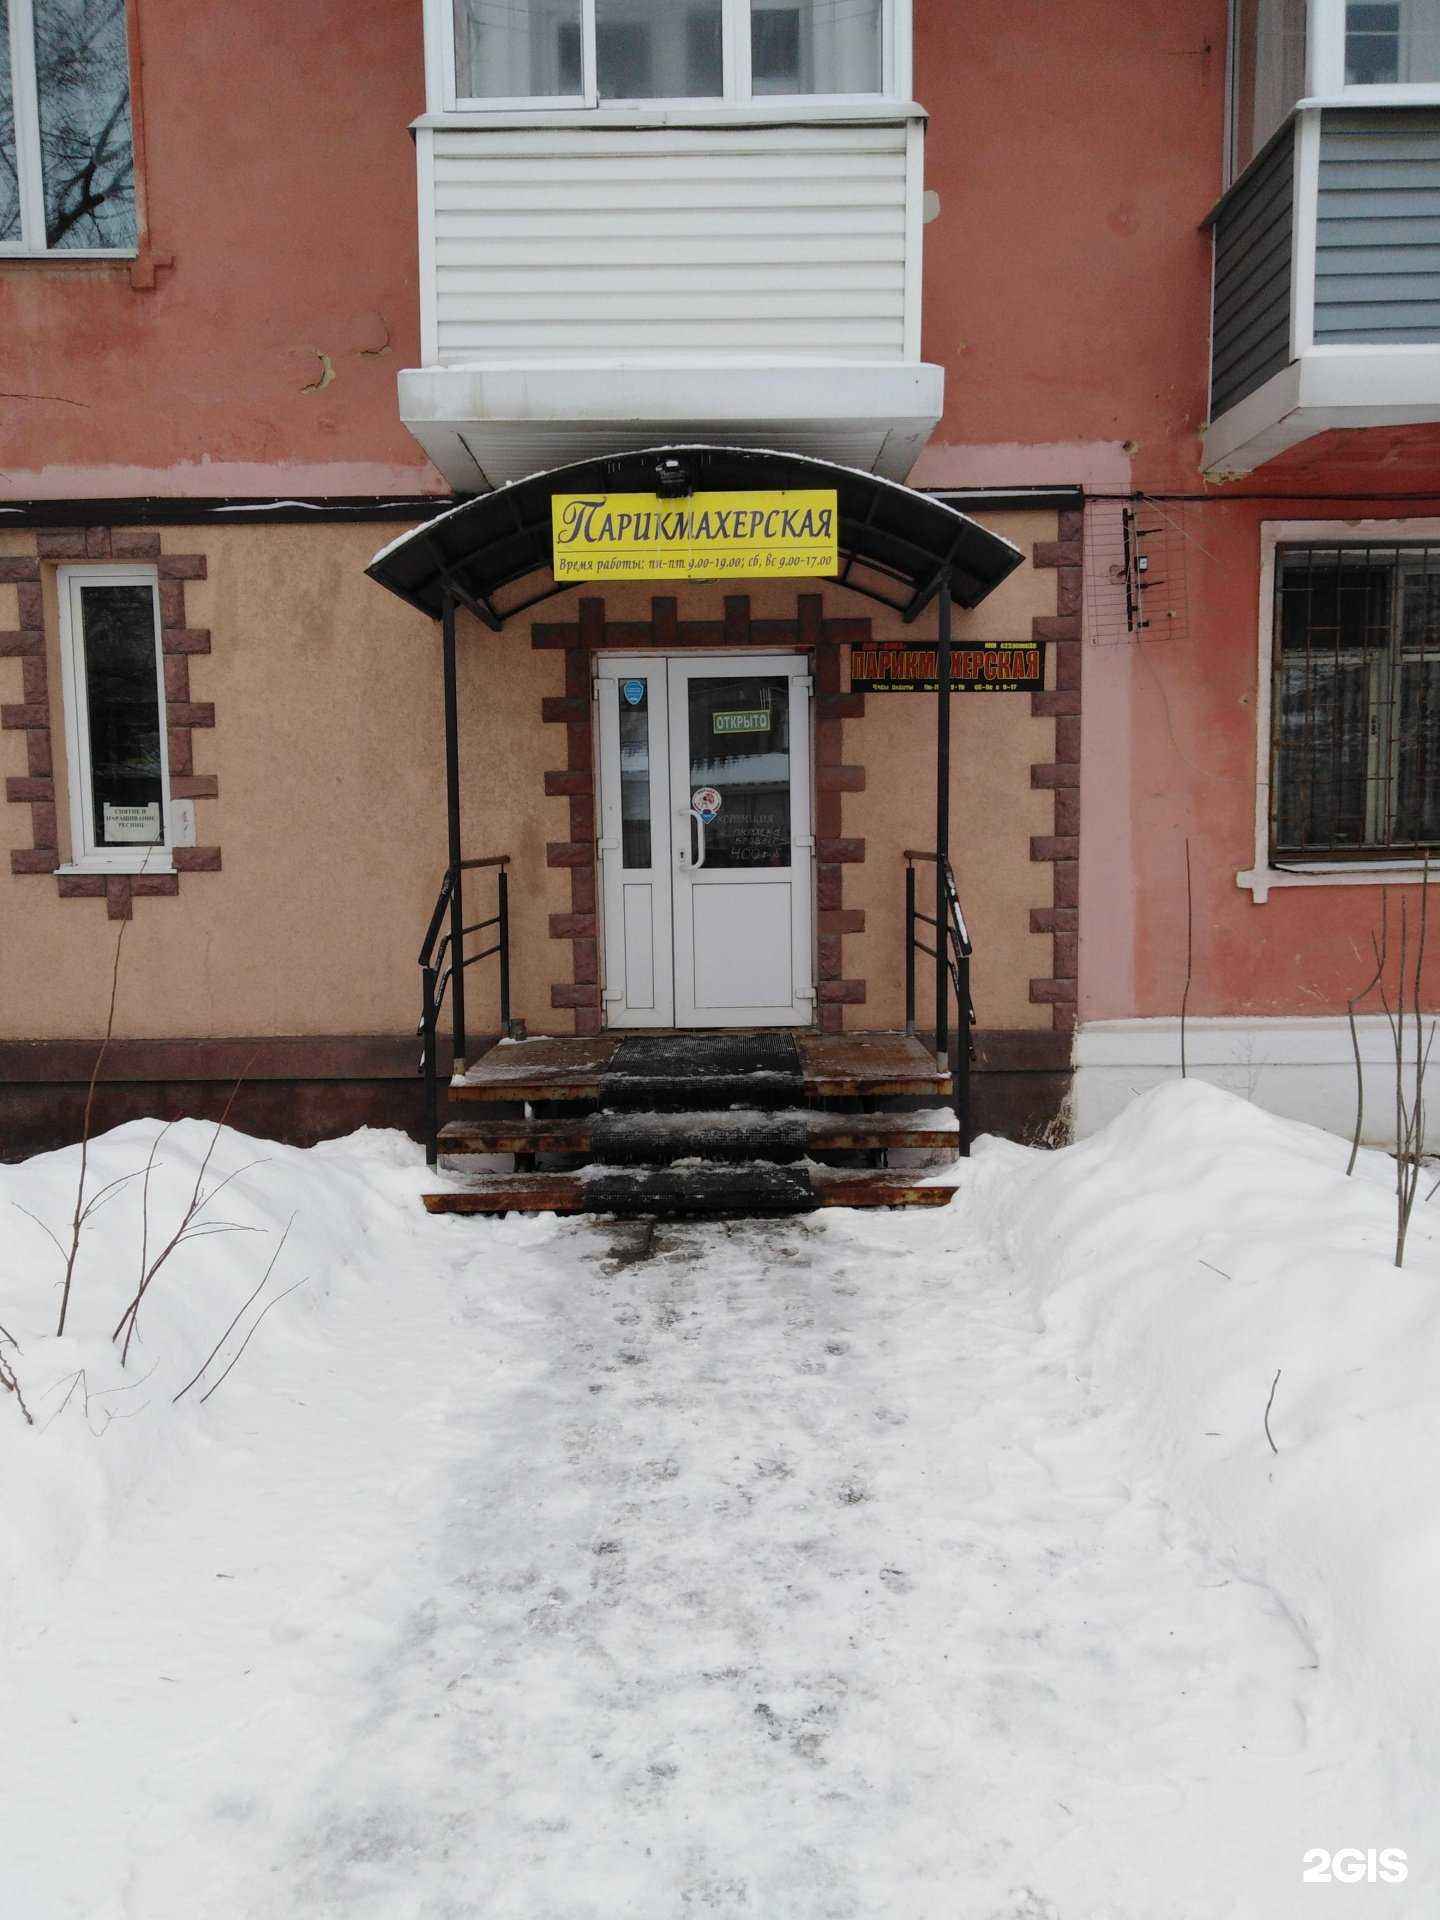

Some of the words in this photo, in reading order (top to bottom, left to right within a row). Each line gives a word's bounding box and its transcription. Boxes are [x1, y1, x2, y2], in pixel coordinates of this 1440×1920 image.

[557, 496, 832, 544] ПАРИКМАХЕРСКАЯ
[559, 557, 593, 573] Время
[597, 556, 645, 572] работы:
[648, 558, 685, 569] пн-пт
[851, 651, 1040, 681] ПАРИКМХЕРСКАЯ
[716, 713, 769, 730] ОТКРЫТО
